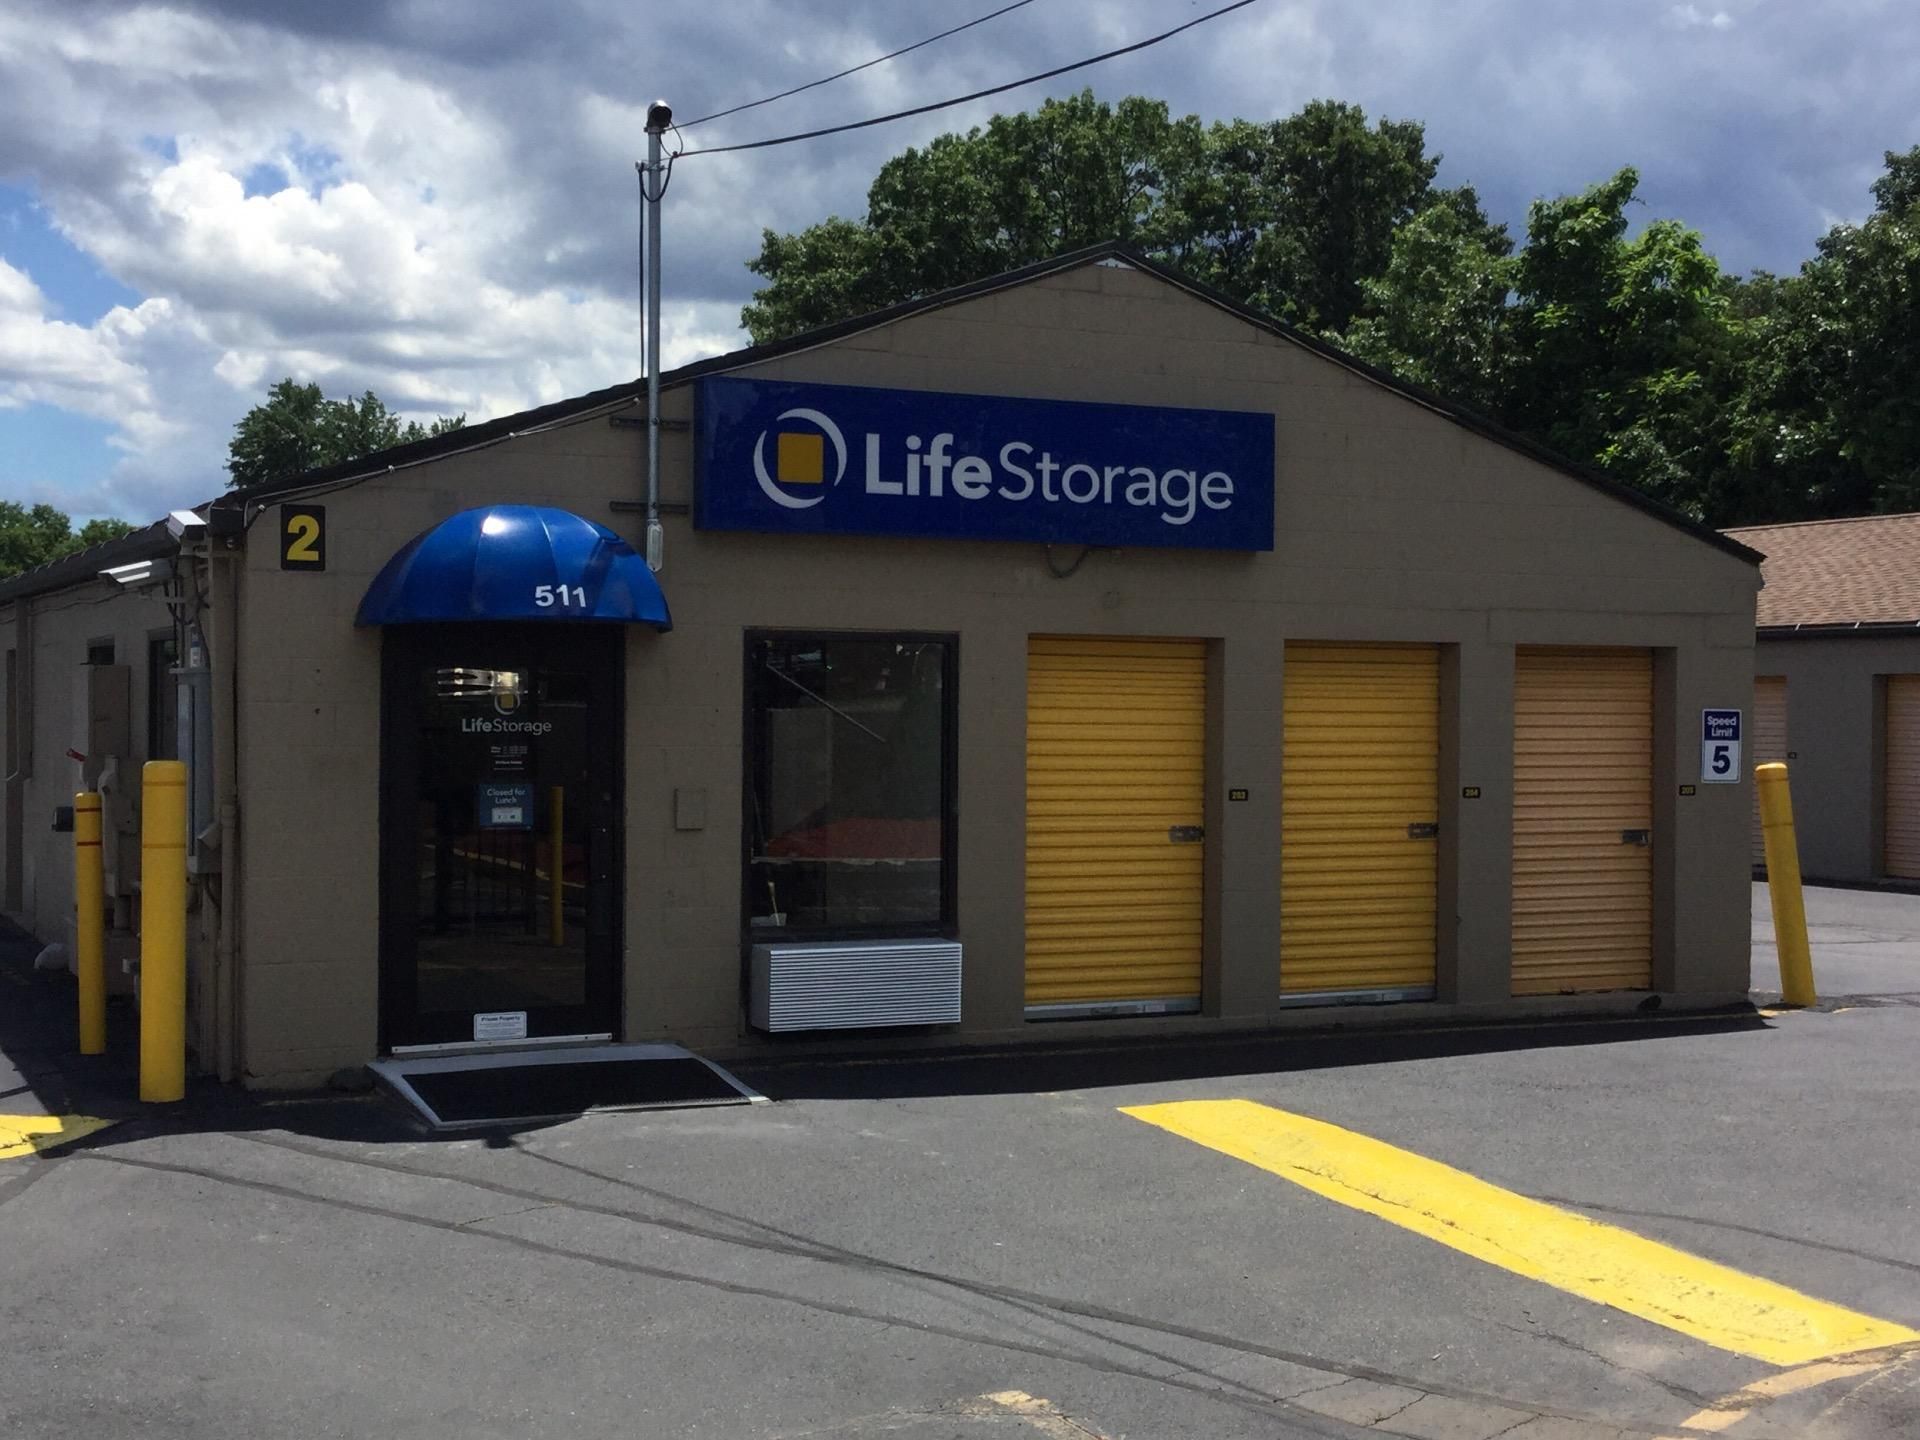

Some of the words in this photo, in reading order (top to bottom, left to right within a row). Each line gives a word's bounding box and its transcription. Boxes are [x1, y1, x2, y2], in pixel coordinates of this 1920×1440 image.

[287, 514, 320, 561] 2
[535, 584, 586, 607] 511
[1707, 715, 1737, 727] Speed
[1711, 727, 1733, 737] Limit
[1711, 745, 1731, 775] 5
[486, 788, 513, 797] Closed
[514, 787, 526, 797] for
[495, 796, 517, 804] Lunch
